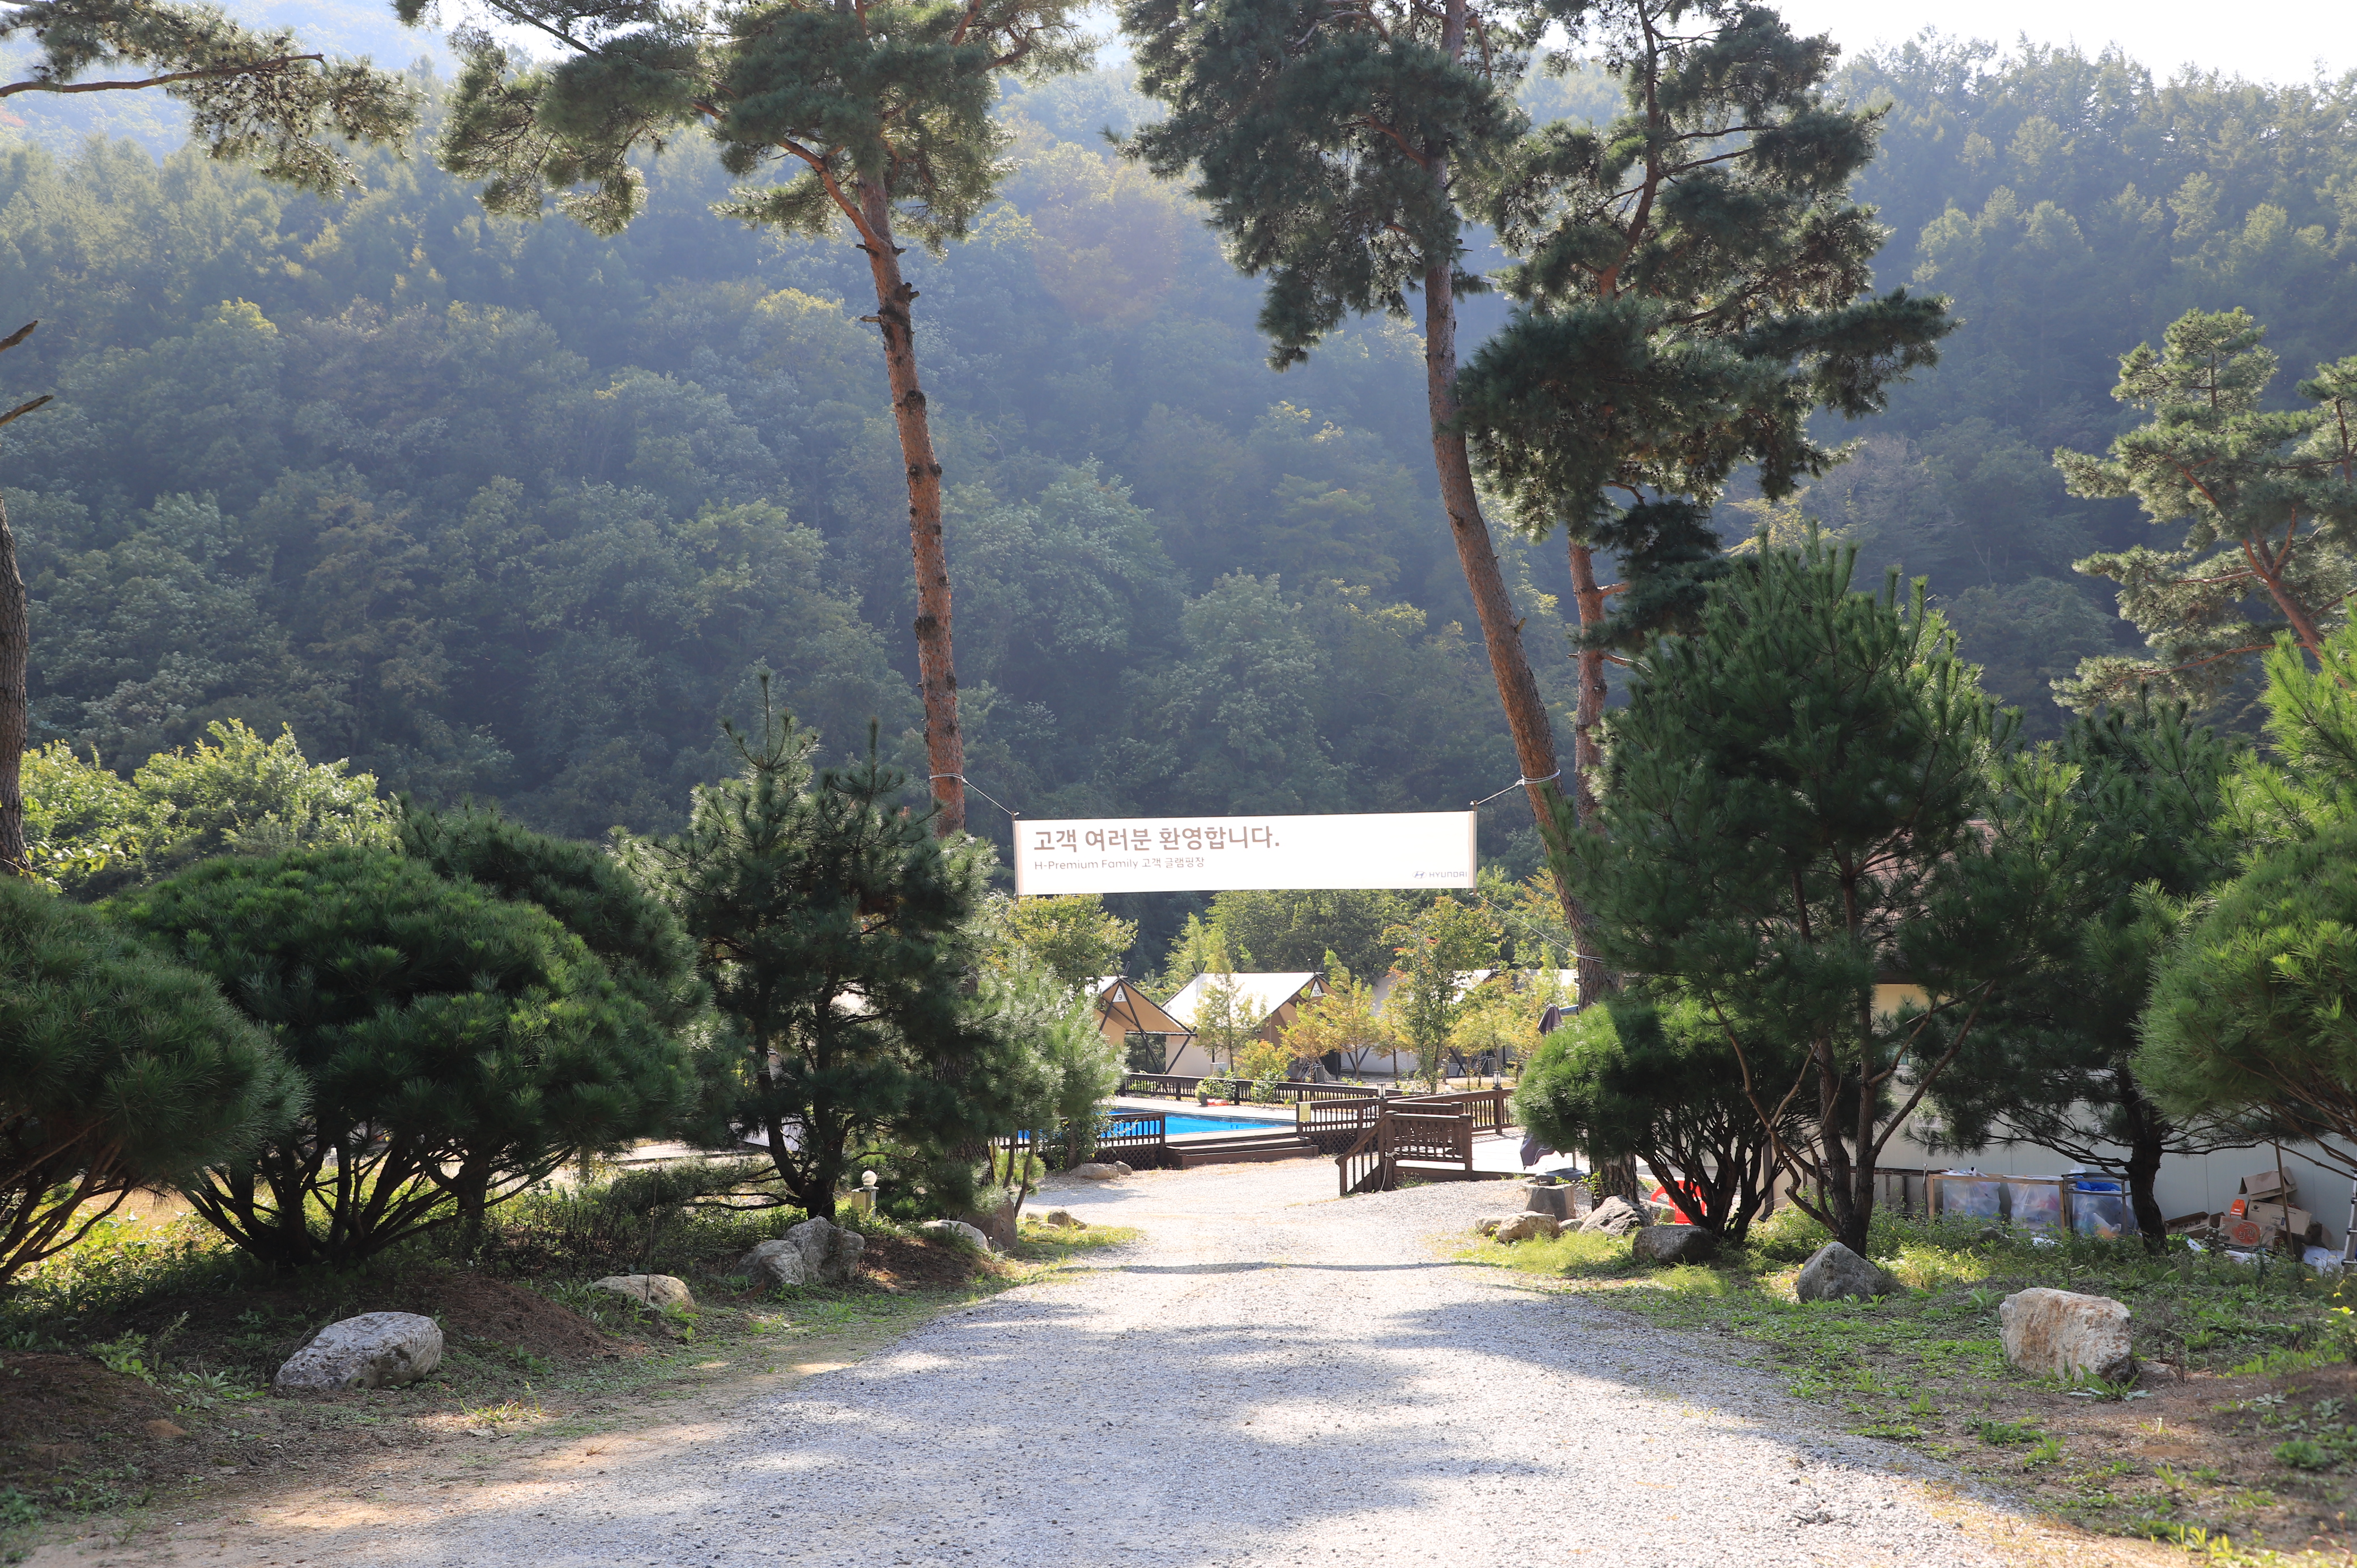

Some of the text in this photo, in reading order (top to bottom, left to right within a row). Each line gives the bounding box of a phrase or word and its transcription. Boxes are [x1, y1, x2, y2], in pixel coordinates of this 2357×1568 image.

[1034, 826, 1279, 853] 고객 여러분 환영합니다.
[1035, 857, 1205, 870] H-Premium Family 고객 글램핑장
